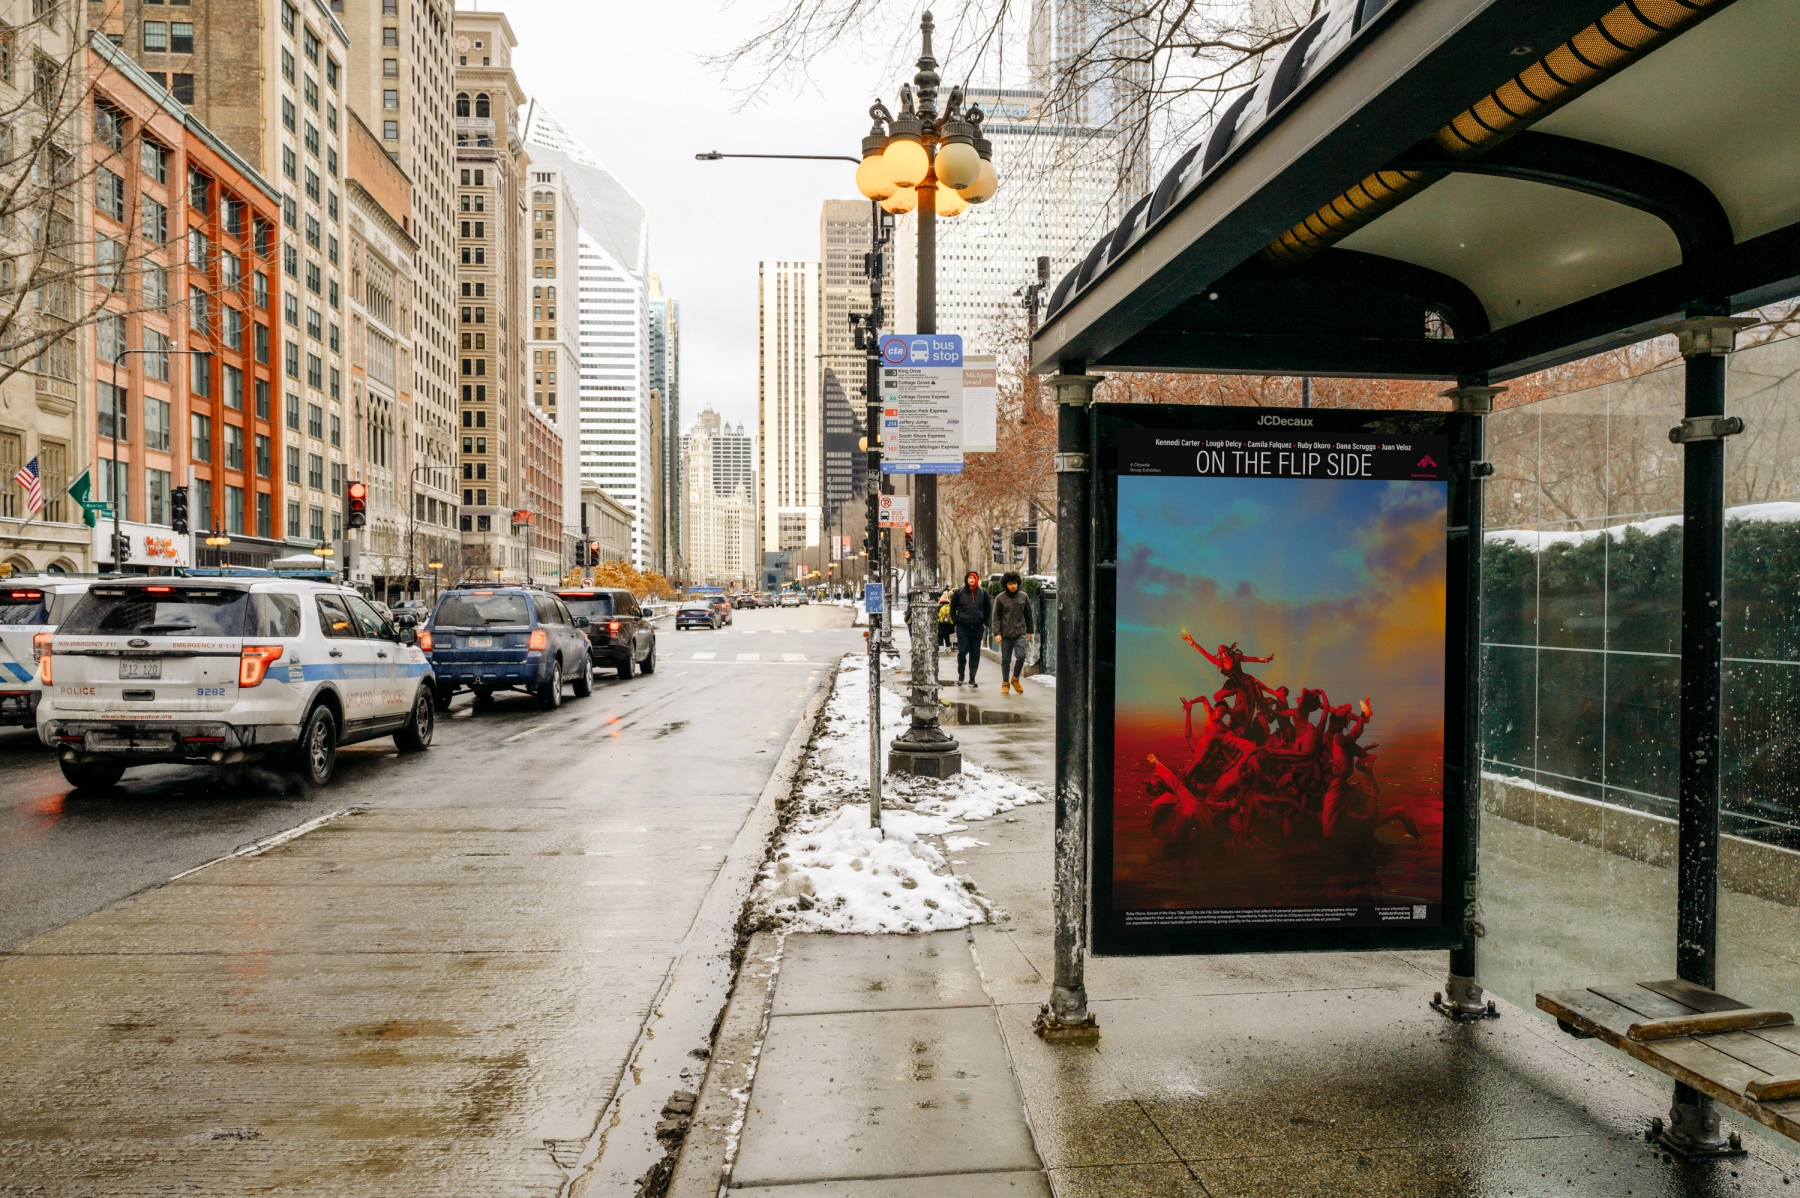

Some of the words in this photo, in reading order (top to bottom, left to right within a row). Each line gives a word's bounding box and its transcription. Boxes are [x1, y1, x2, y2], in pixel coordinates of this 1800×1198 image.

[933, 340, 954, 350] bus
[933, 352, 959, 363] stop
[1257, 415, 1314, 426] JCDecaux
[1206, 440, 1224, 448] Lougè
[1297, 442, 1312, 450] Ruby
[1352, 443, 1376, 451] Scruggs
[1197, 450, 1225, 473] ON
[1232, 451, 1271, 474] THE
[1279, 452, 1320, 475] FLIP
[1327, 453, 1372, 476] SIDE
[129, 664, 138, 675] 12
[143, 665, 158, 675] 120
[61, 687, 95, 695] POLICE
[346, 691, 374, 708] CHICAGO
[382, 690, 403, 704] POLICE
